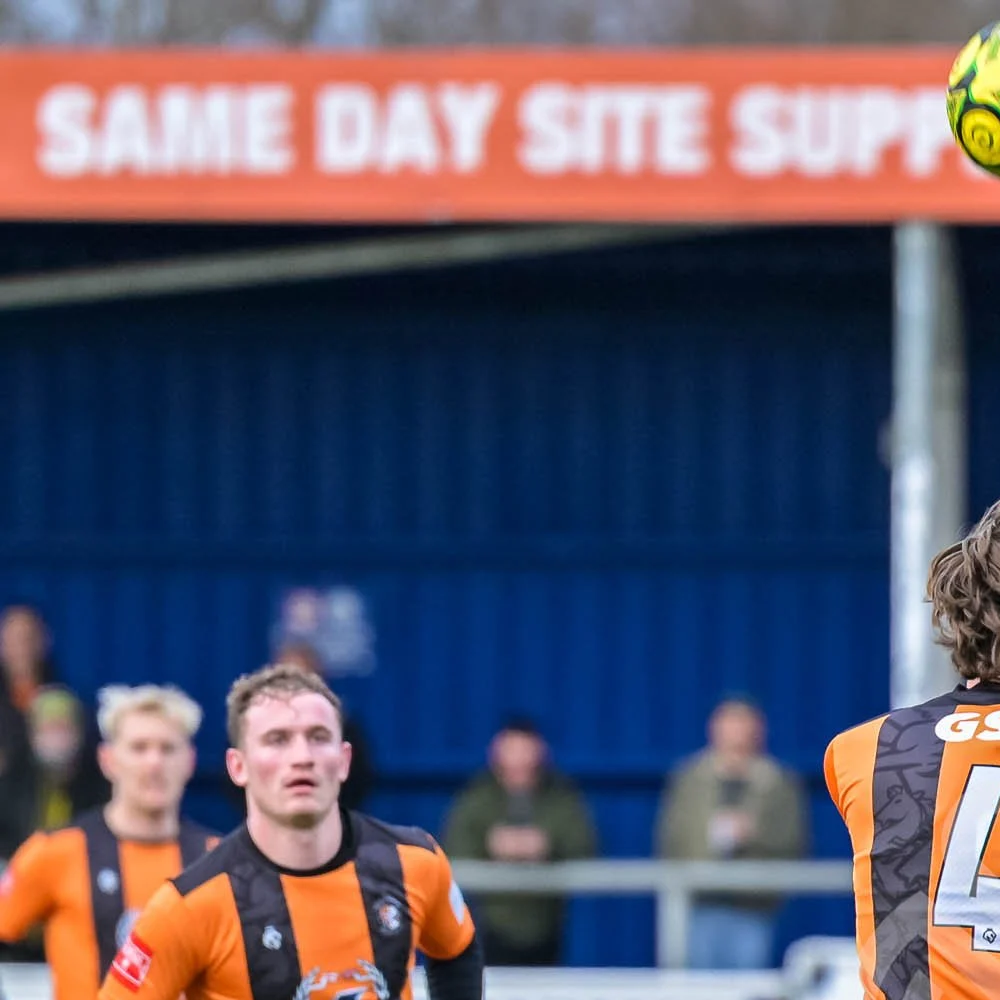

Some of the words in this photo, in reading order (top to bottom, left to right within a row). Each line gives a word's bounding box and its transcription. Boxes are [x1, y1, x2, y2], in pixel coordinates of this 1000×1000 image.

[37, 84, 294, 178] SAME
[314, 82, 499, 176] DAY
[518, 83, 708, 176] SITE
